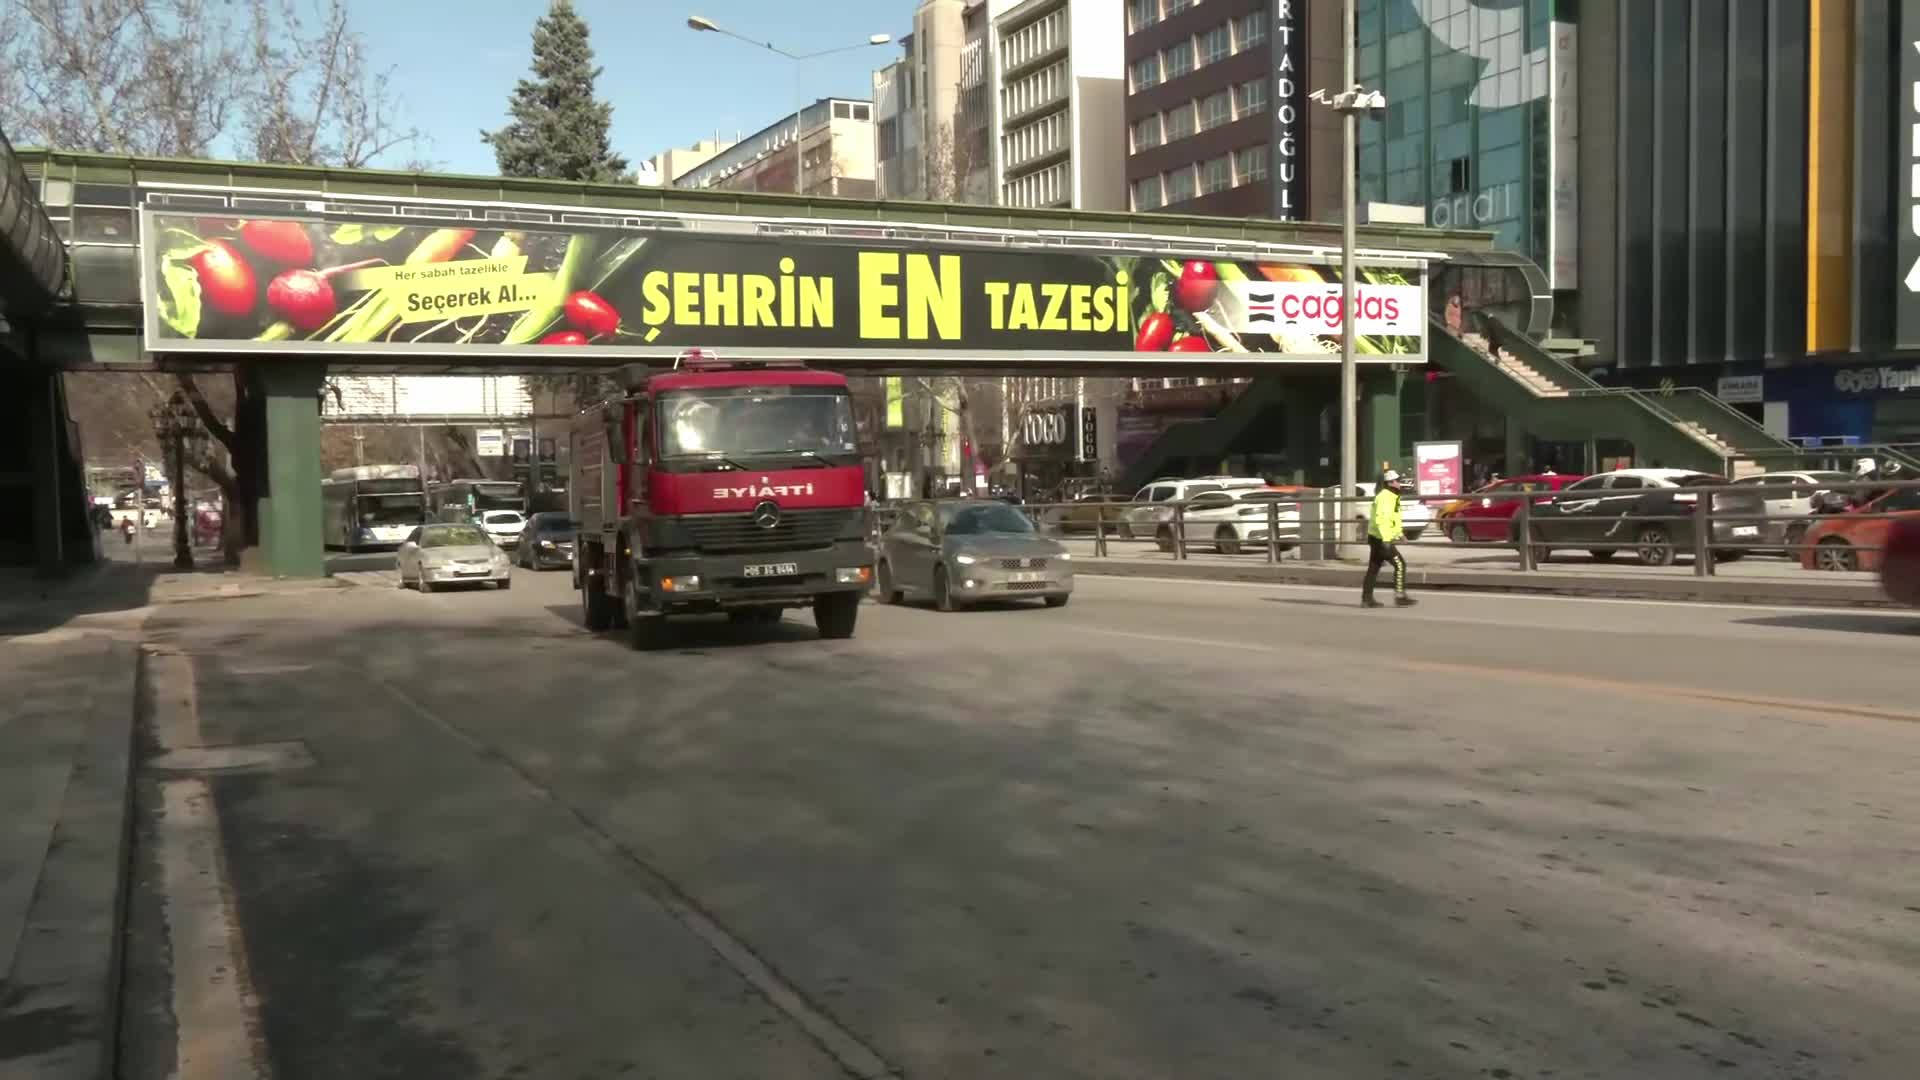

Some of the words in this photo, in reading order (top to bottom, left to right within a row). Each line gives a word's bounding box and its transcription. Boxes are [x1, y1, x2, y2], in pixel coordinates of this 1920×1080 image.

[1278, 0, 1296, 222] RTADOĞUL
[395, 271, 416, 281] Her
[421, 265, 456, 279] sabah
[460, 263, 509, 276] tazelikle
[407, 287, 491, 314] Seçerek
[498, 284, 537, 303] Al...
[641, 257, 834, 343] ŞEHRİN
[858, 252, 962, 340] EN
[985, 270, 1129, 333] TAZESİ
[1023, 413, 1066, 445] TOGO
